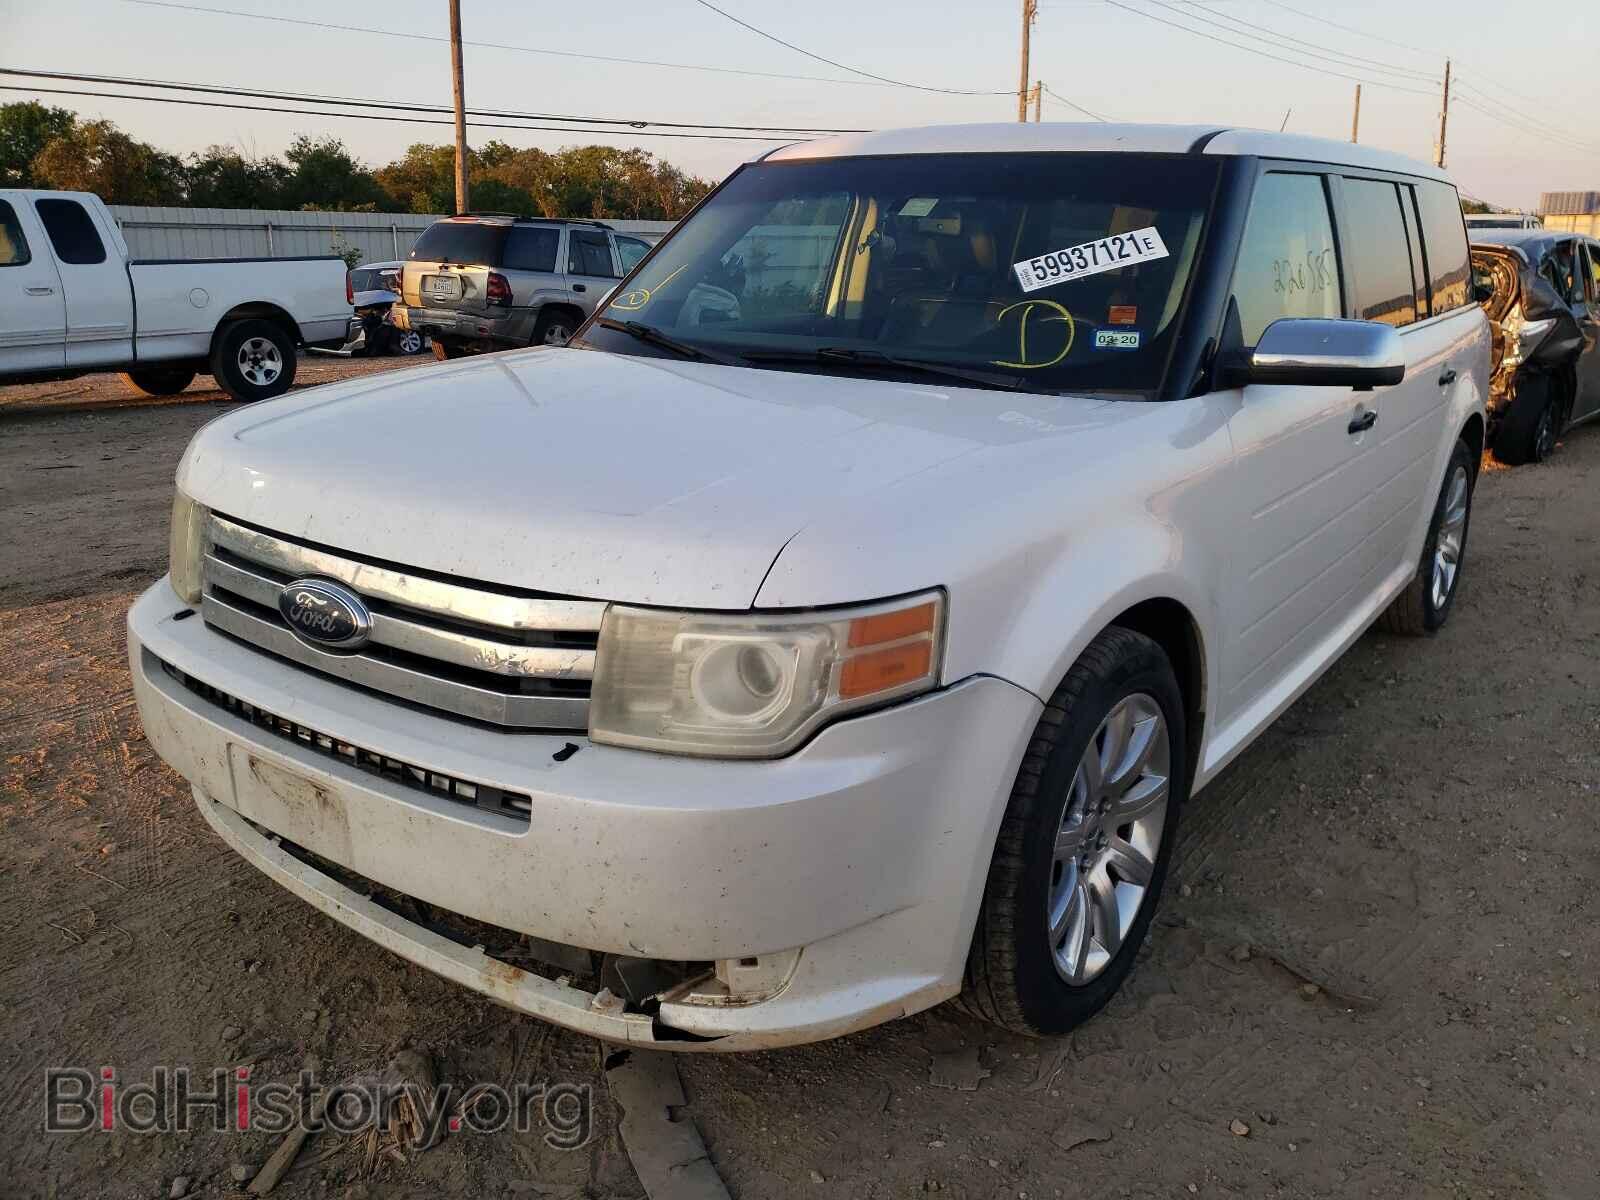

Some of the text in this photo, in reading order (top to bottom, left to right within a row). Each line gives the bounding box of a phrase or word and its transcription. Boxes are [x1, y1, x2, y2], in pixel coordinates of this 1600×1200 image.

[1031, 233, 1143, 281] 59937121
[1144, 237, 1155, 250] E
[289, 591, 337, 633] Ford
